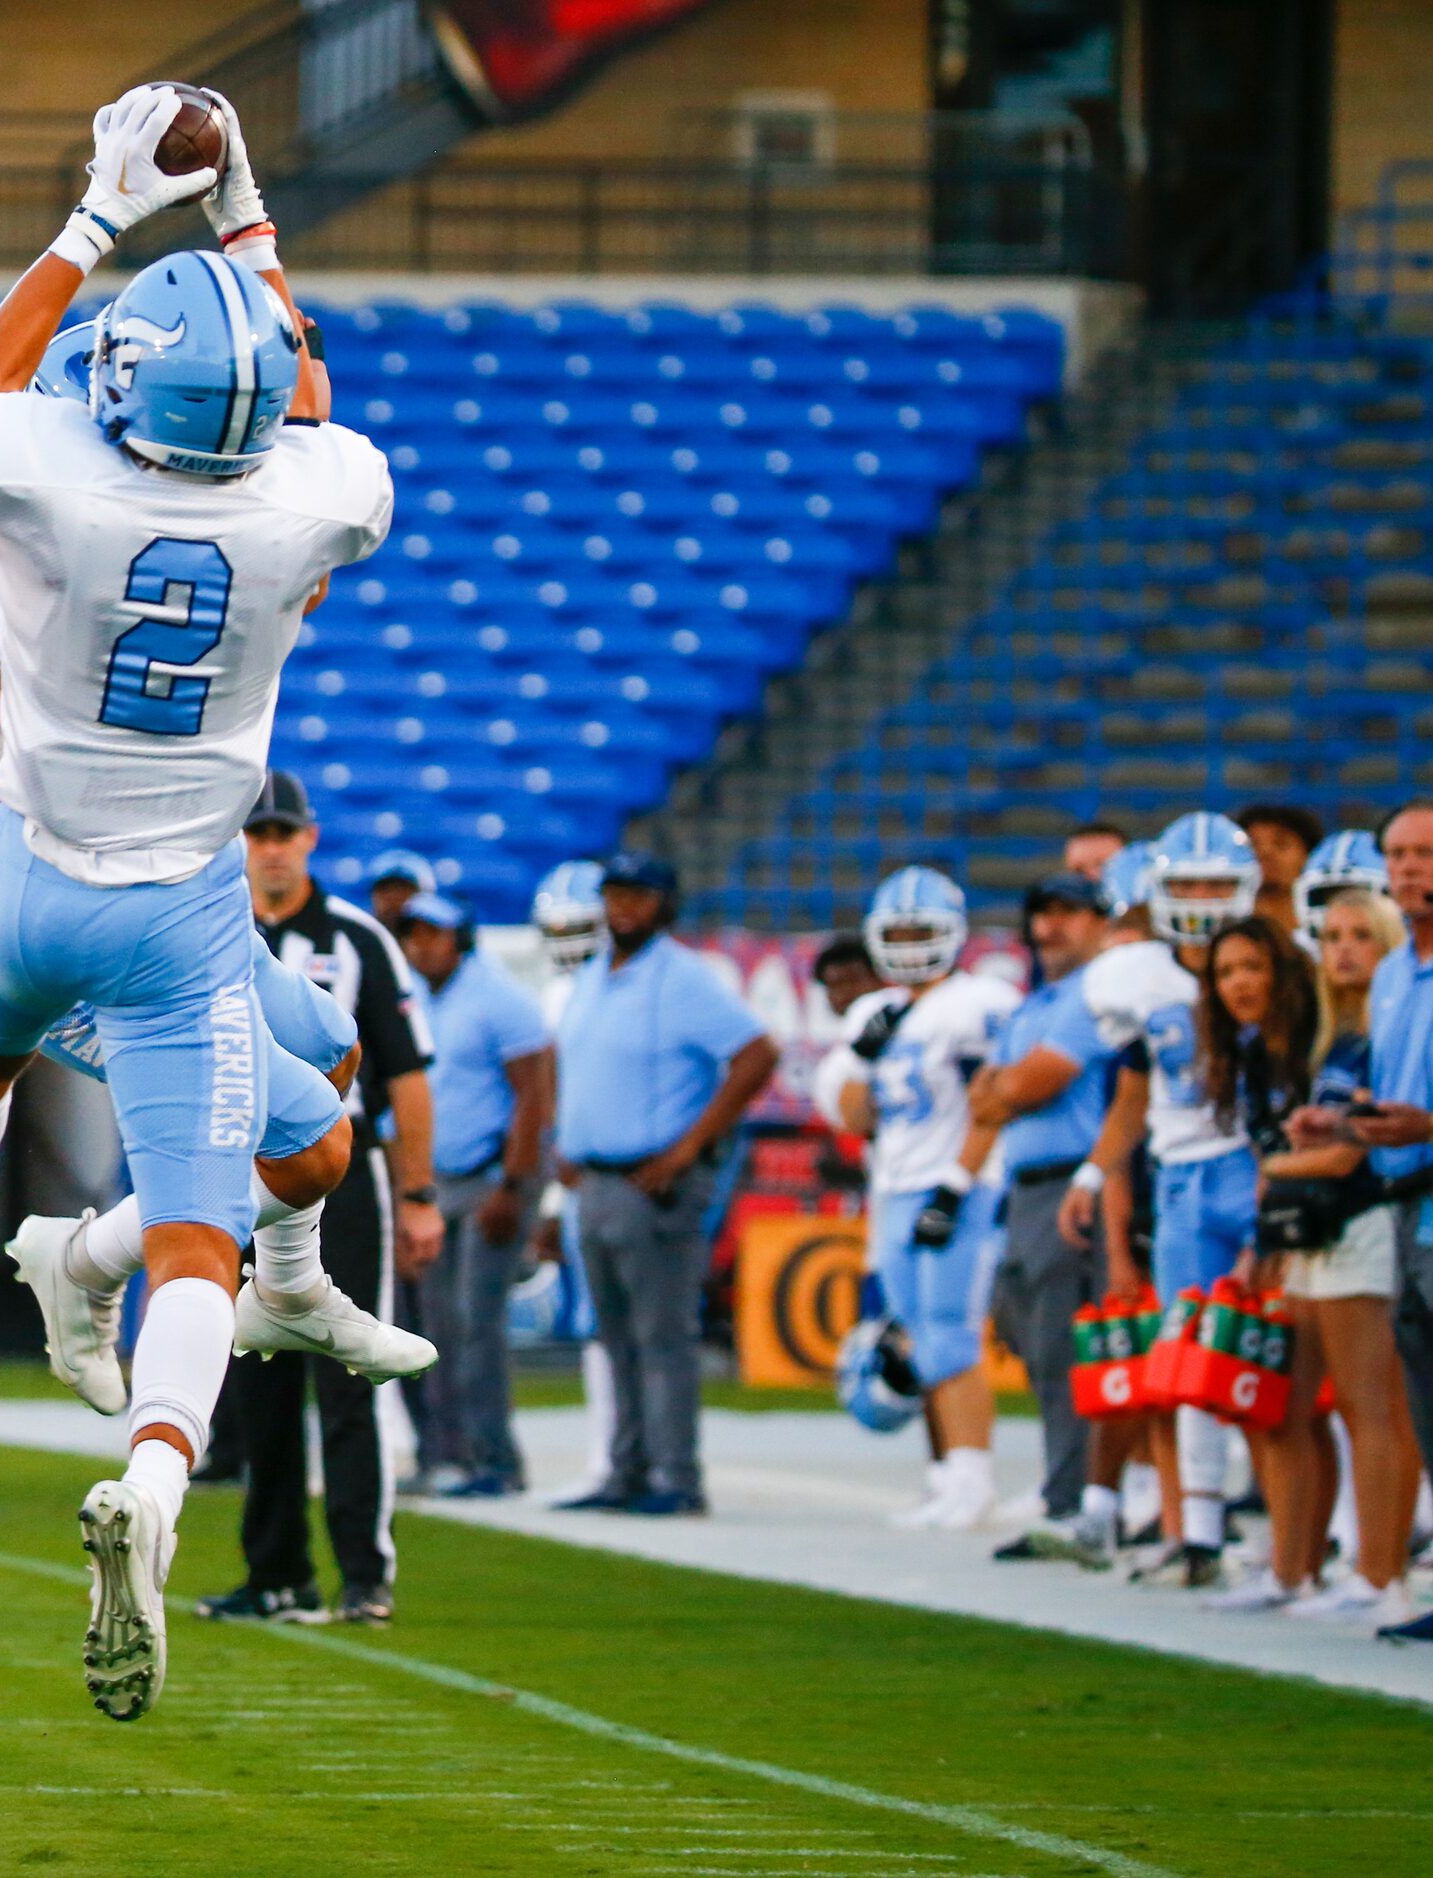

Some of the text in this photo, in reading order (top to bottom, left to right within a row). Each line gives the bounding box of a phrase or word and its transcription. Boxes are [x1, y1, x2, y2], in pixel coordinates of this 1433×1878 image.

[98, 536, 233, 735] 2
[1101, 1366, 1132, 1406] G
[1232, 1372, 1260, 1409] G
